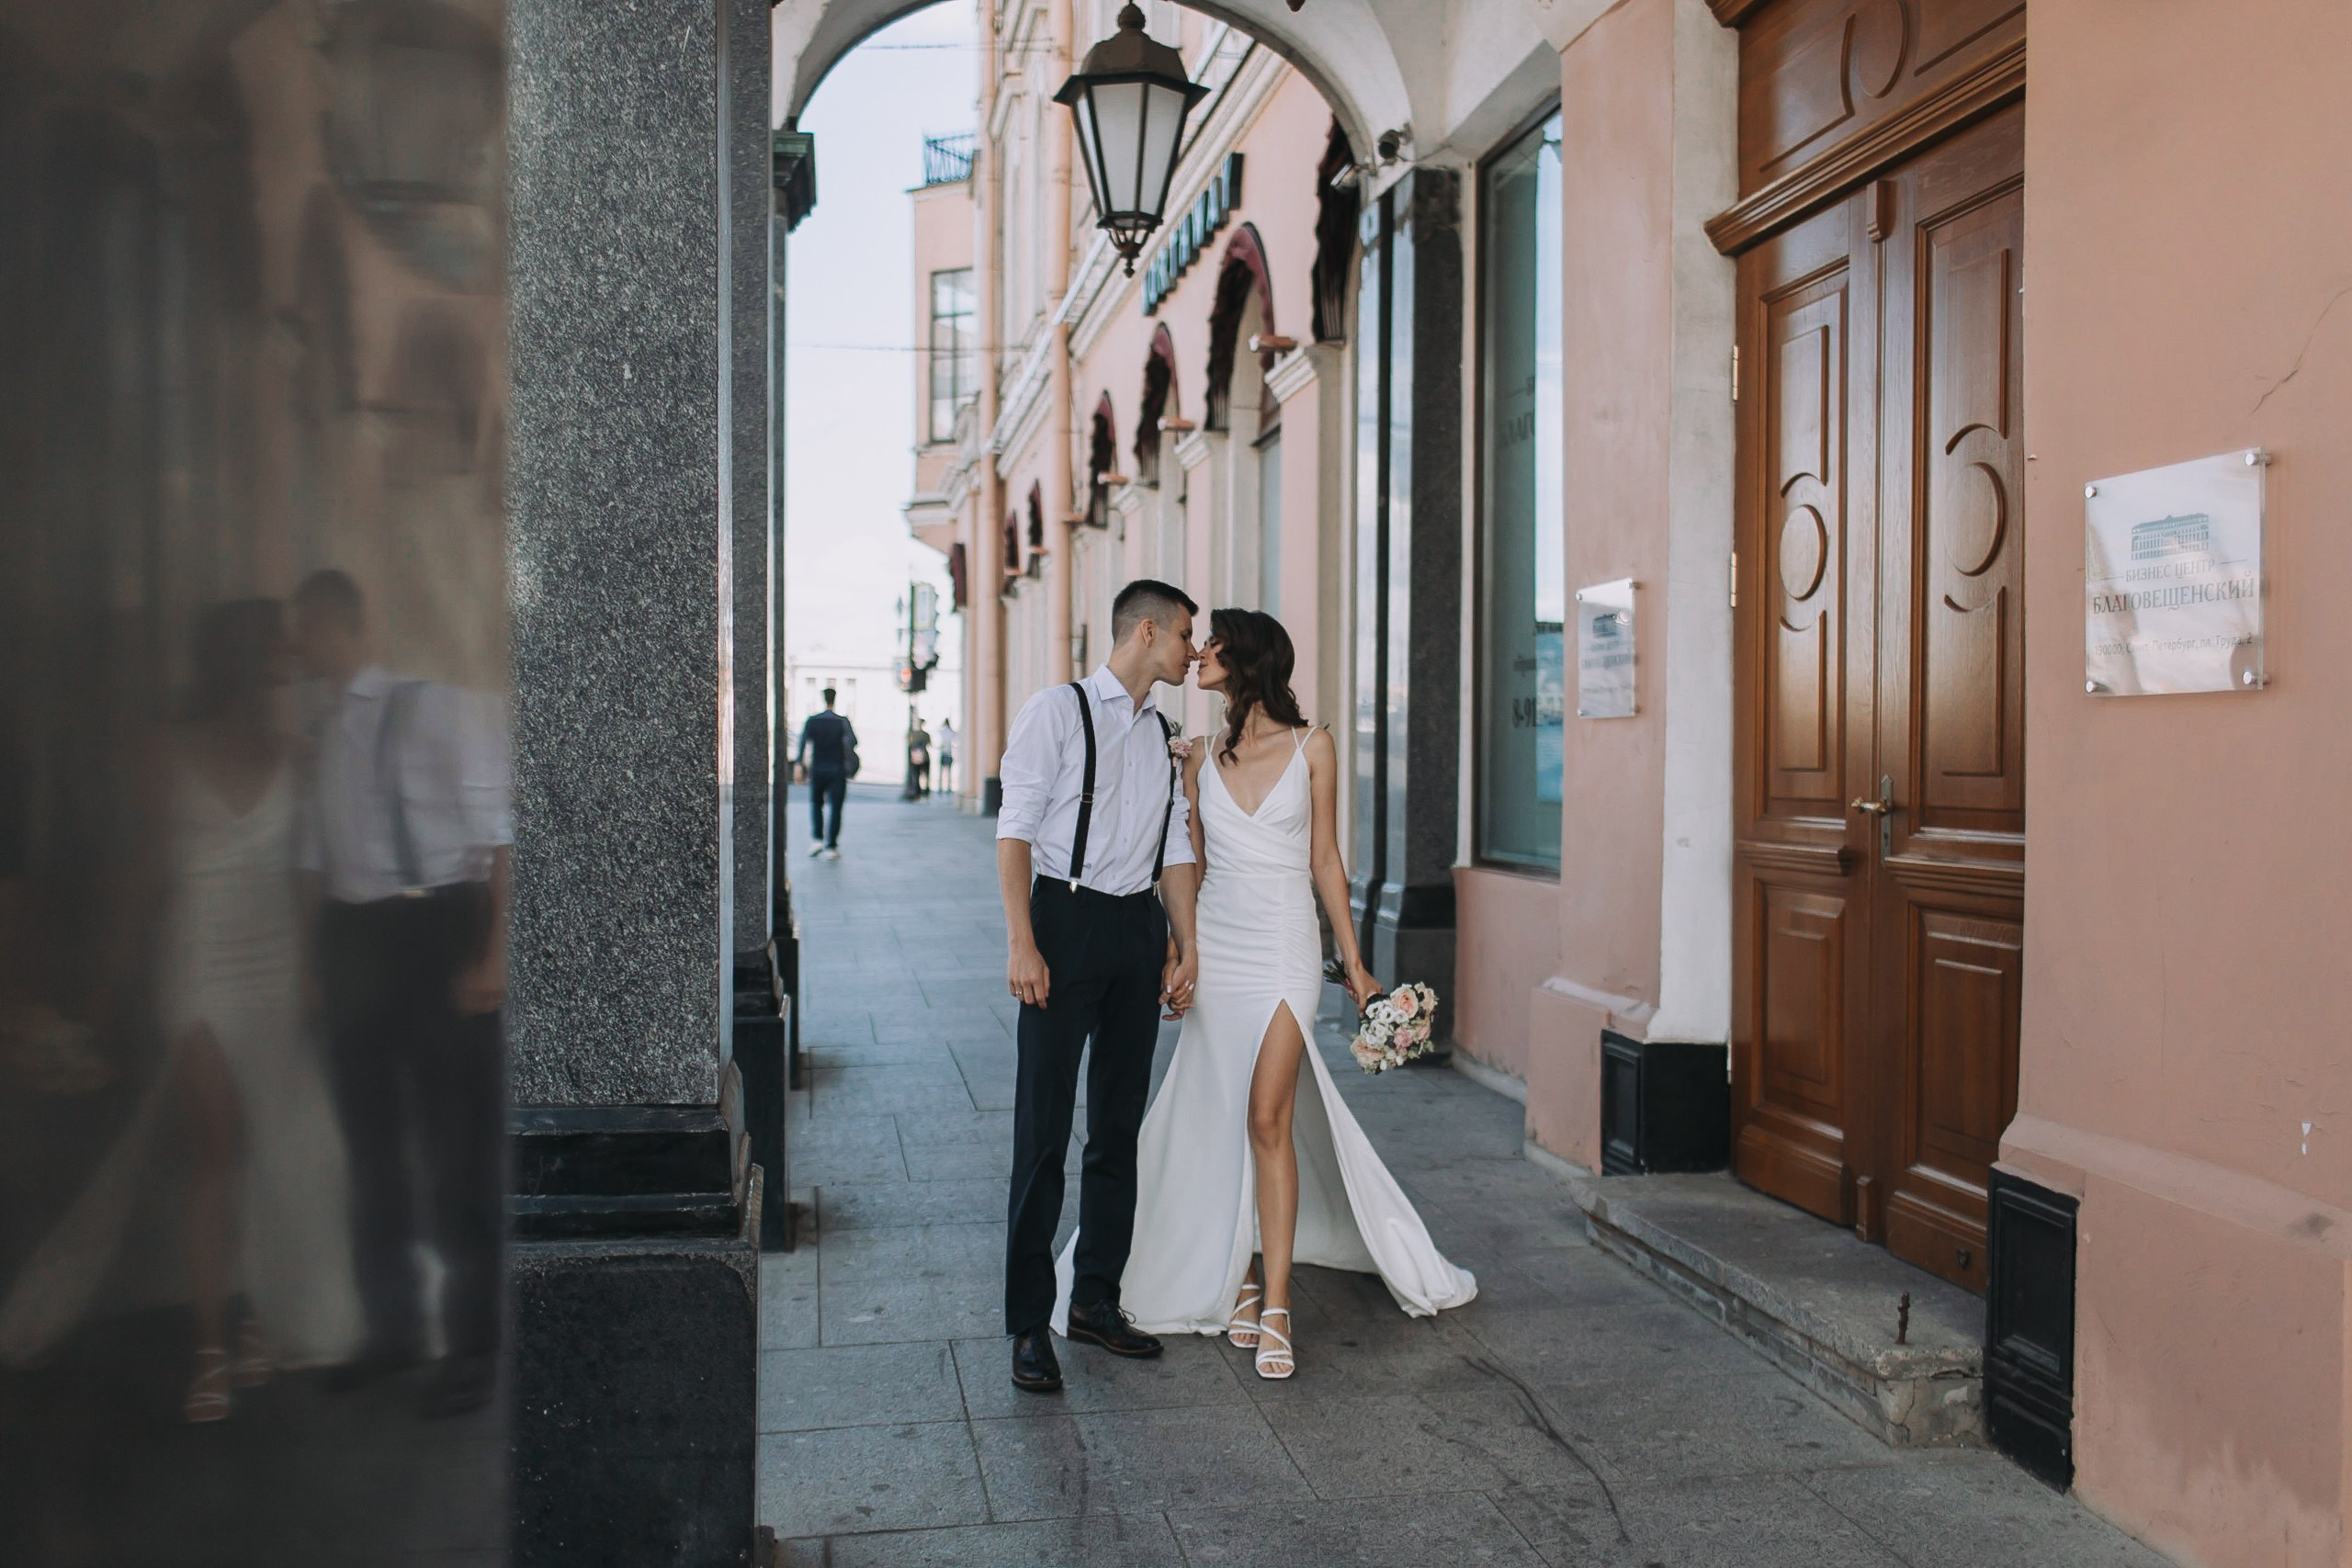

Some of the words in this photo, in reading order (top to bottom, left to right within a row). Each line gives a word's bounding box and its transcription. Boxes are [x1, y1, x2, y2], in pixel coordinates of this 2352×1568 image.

[2125, 564, 2171, 582] БИЗНЕС
[2175, 558, 2215, 579] ЦЕНТР
[2093, 570, 2254, 615] БЛАГОВЕЩЕНСКИЙ
